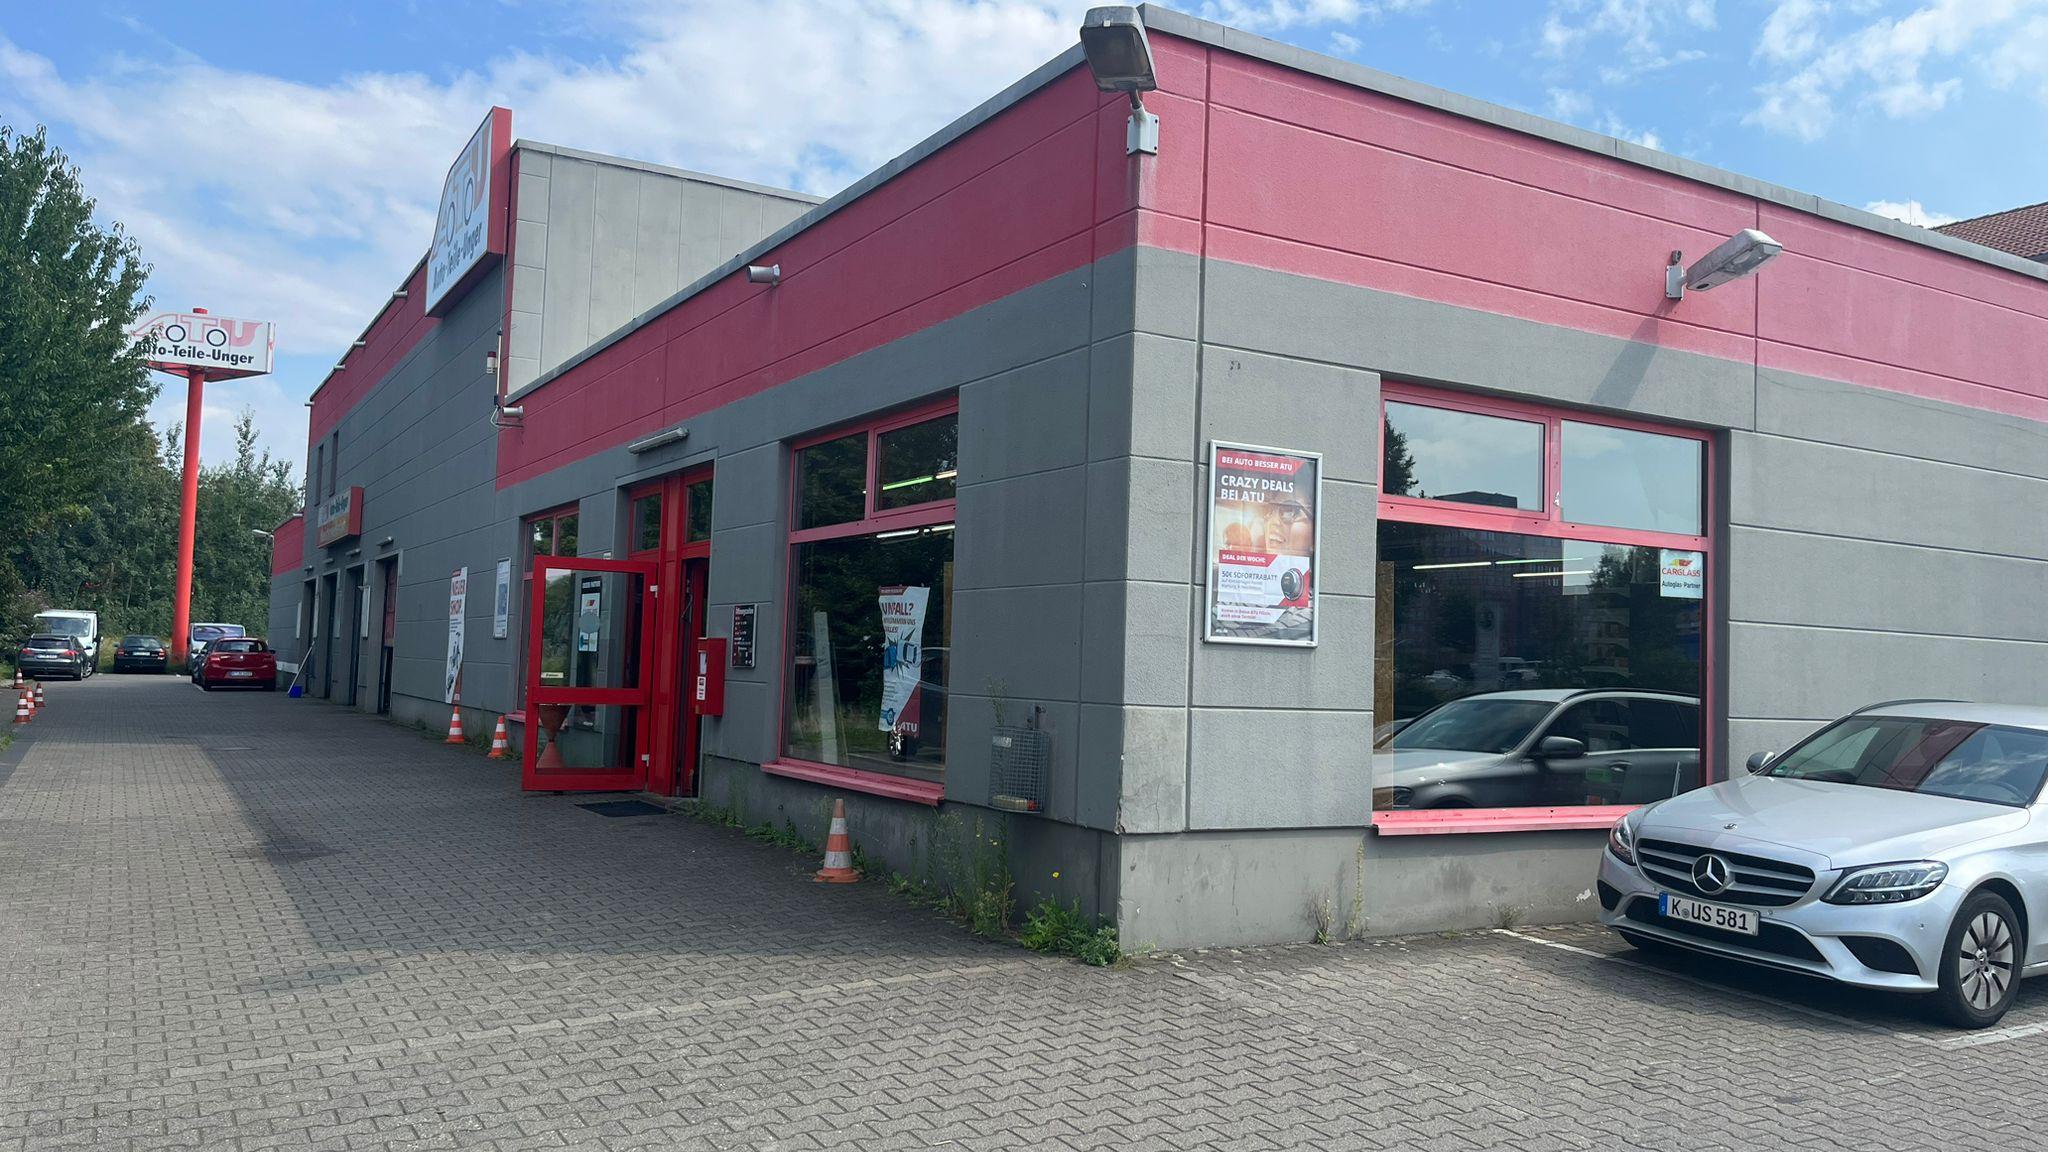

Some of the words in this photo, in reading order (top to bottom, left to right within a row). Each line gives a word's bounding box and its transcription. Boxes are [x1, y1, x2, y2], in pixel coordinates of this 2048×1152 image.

[1222, 456, 1233, 464] BEI
[1234, 458, 1253, 467] AUTO
[1254, 460, 1279, 470] BESSER
[1280, 463, 1293, 472] ATU
[1221, 475, 1259, 490] CRAZY
[1262, 479, 1294, 493] DEALS
[1221, 488, 1239, 501] BEI
[1242, 492, 1265, 503] ATU
[1662, 568, 1701, 577] CARGLASS
[898, 721, 918, 733] ATU
[1671, 898, 1682, 916] K
[1691, 902, 1712, 923] US
[1716, 908, 1748, 931] 581
